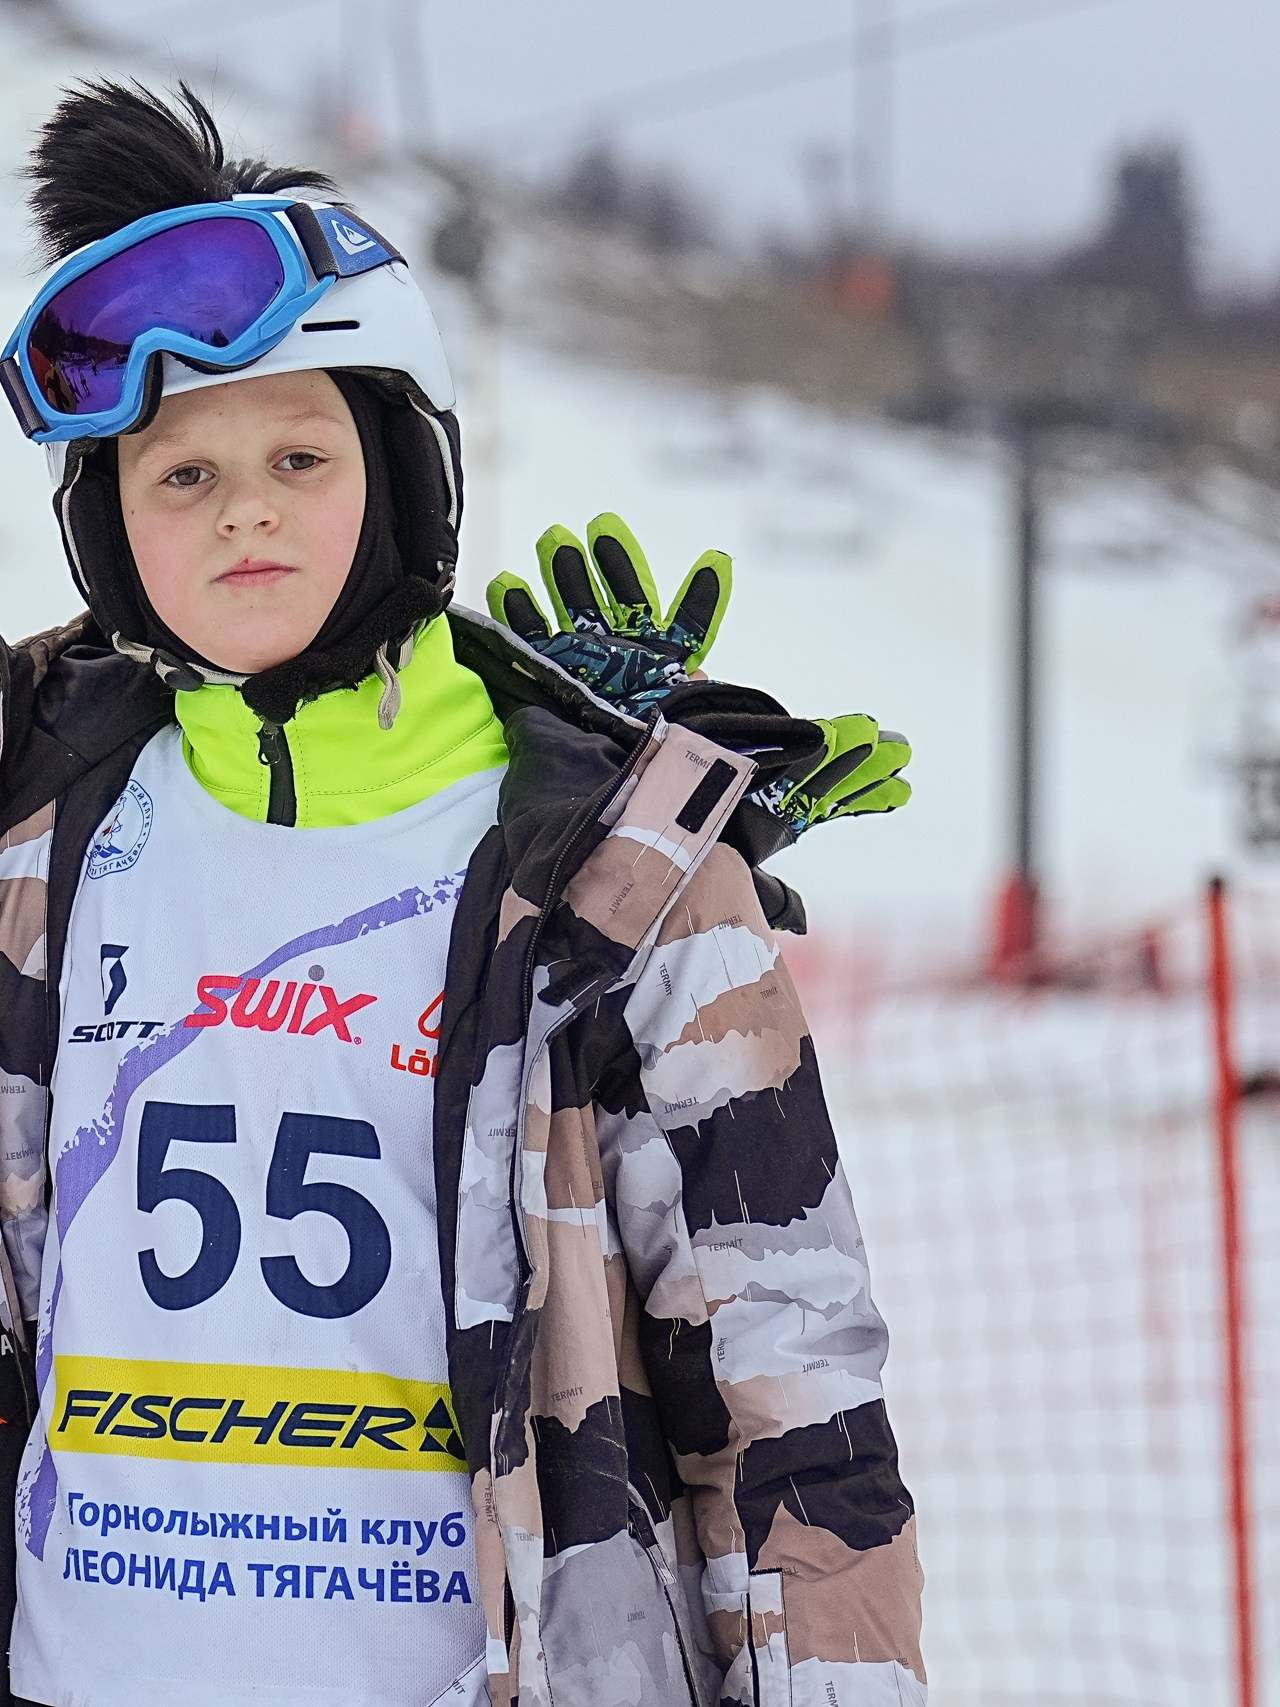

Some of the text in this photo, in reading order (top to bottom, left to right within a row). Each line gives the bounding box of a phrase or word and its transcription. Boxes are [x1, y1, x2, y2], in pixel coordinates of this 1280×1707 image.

[684, 750, 712, 770] TERMI
[608, 881, 635, 915] TERMIT
[717, 914, 743, 930] TERMIT
[658, 962, 673, 997] TERMIT
[67, 1021, 165, 1043] SCOTT
[663, 1096, 700, 1115] TERMIT
[488, 1127, 516, 1138] ERMIT
[137, 1100, 391, 1319] 55
[708, 1237, 743, 1253] TERMIT
[802, 1358, 830, 1374] TERMIT
[551, 1386, 584, 1403] TERMIT
[57, 1389, 416, 1451] FISCHER
[66, 1492, 467, 1555] Горнолыжный клуб
[63, 1547, 473, 1604] ЛЕОНИДА ТЯГАЧЁВА
[824, 1680, 839, 1707] TERM
